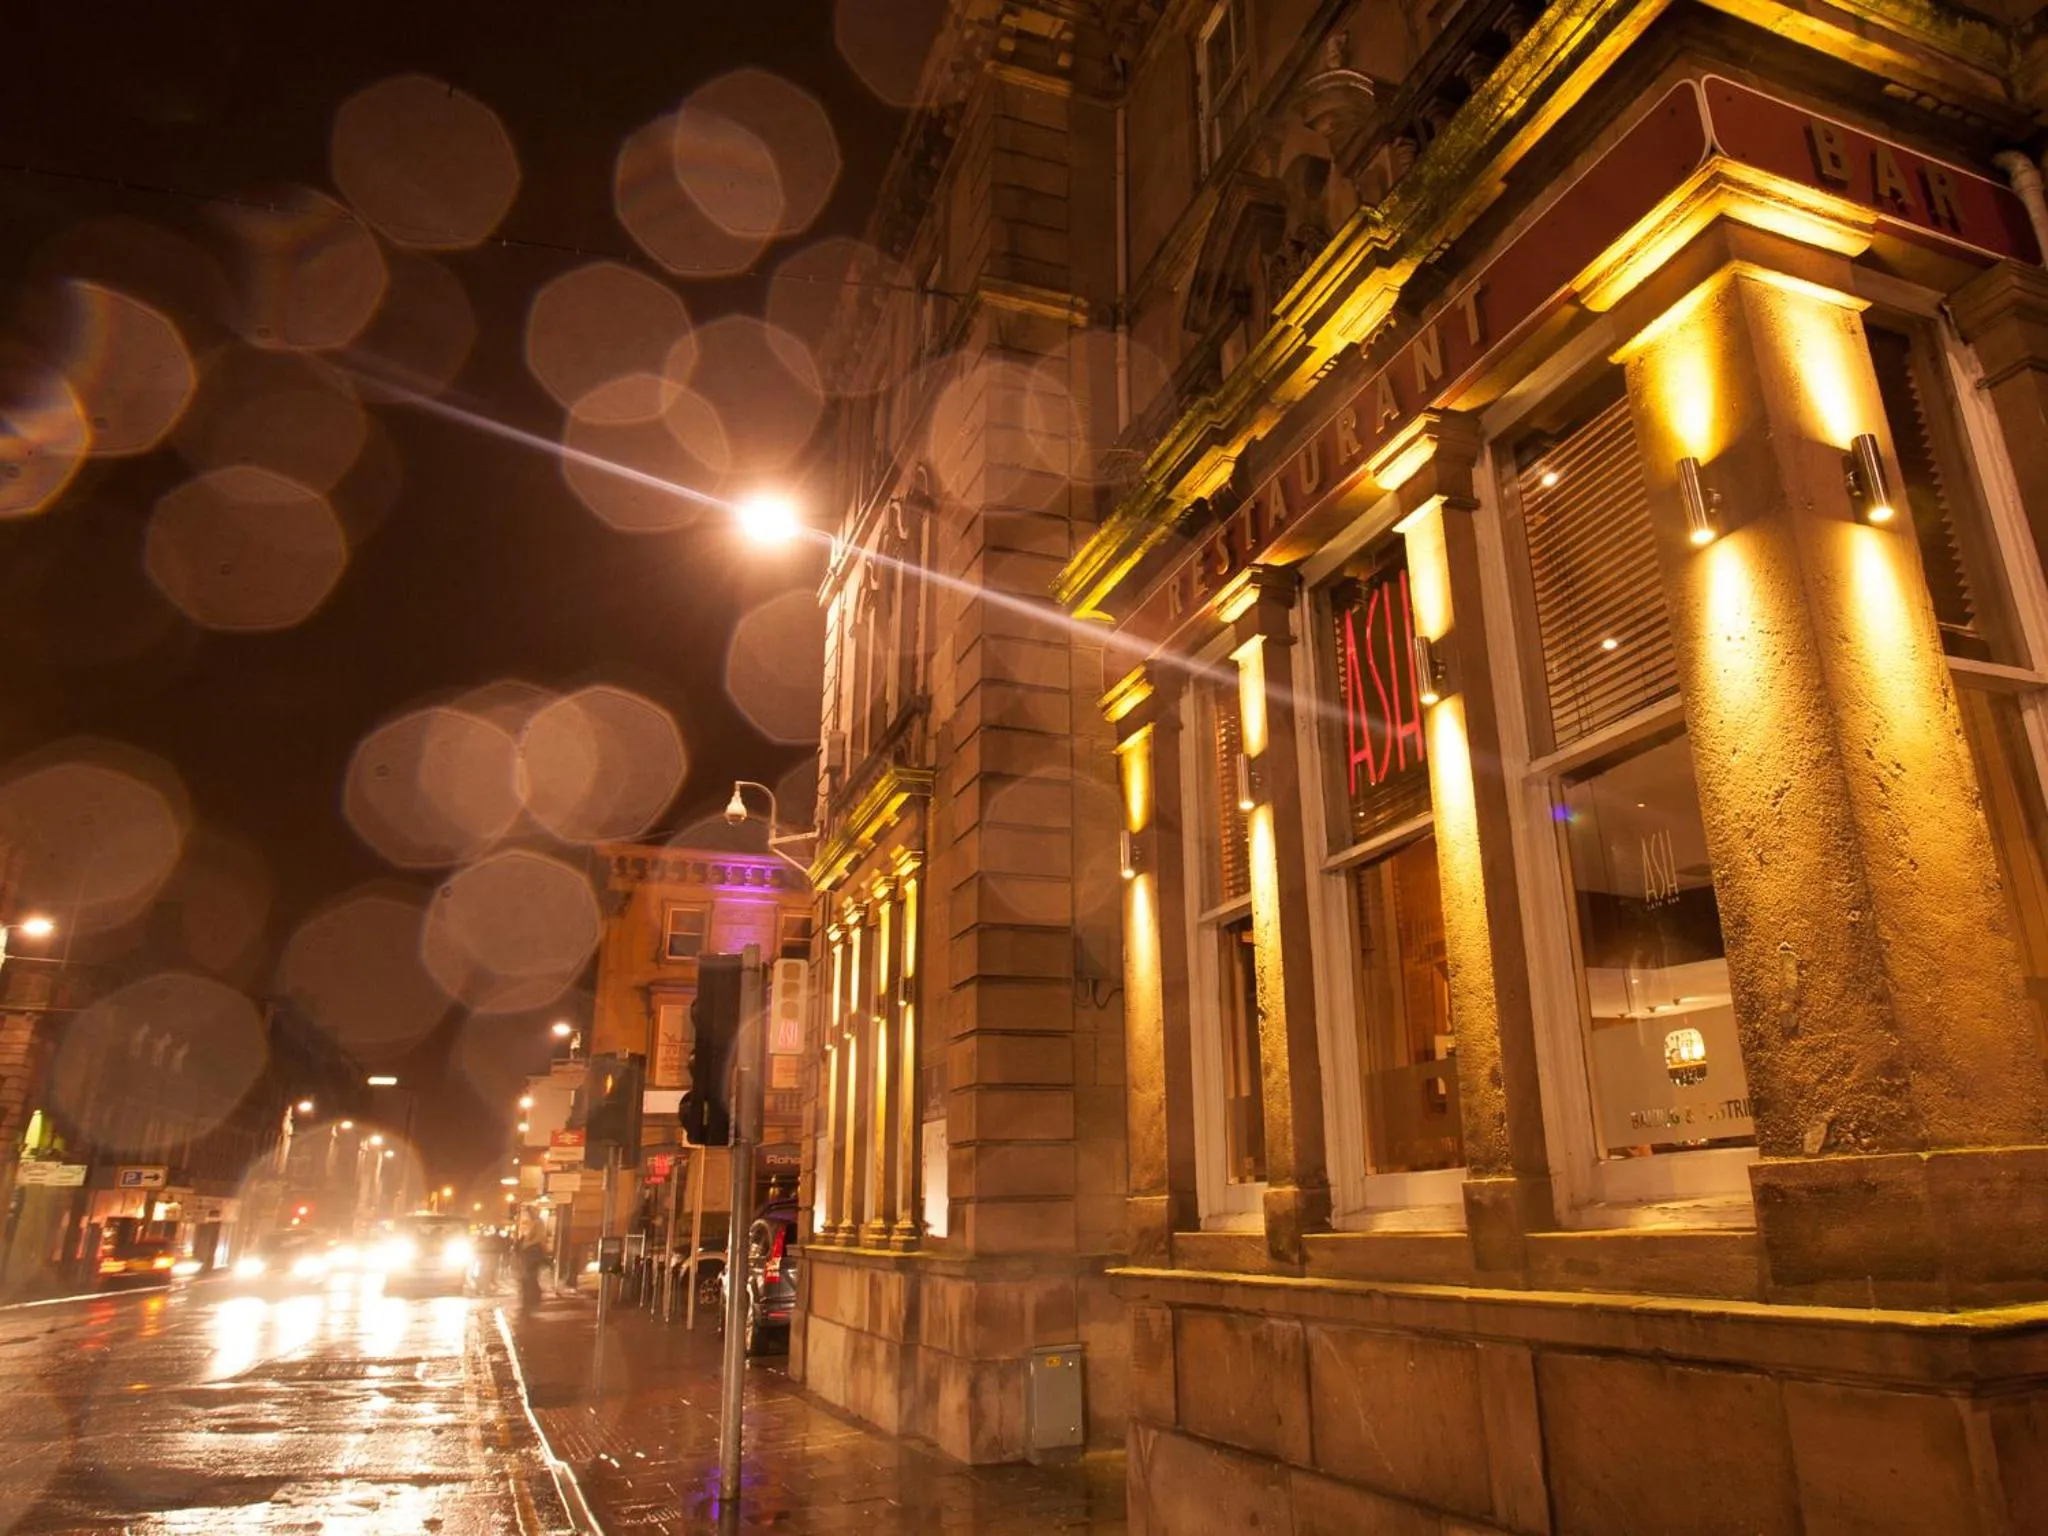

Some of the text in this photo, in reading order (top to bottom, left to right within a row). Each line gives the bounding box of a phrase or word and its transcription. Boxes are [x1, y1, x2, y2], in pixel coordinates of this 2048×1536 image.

[1805, 118, 1964, 233] BAR
[1167, 279, 1486, 620] RESTAURANT
[1345, 569, 1424, 797] ASH
[1641, 829, 1679, 903] ASH
